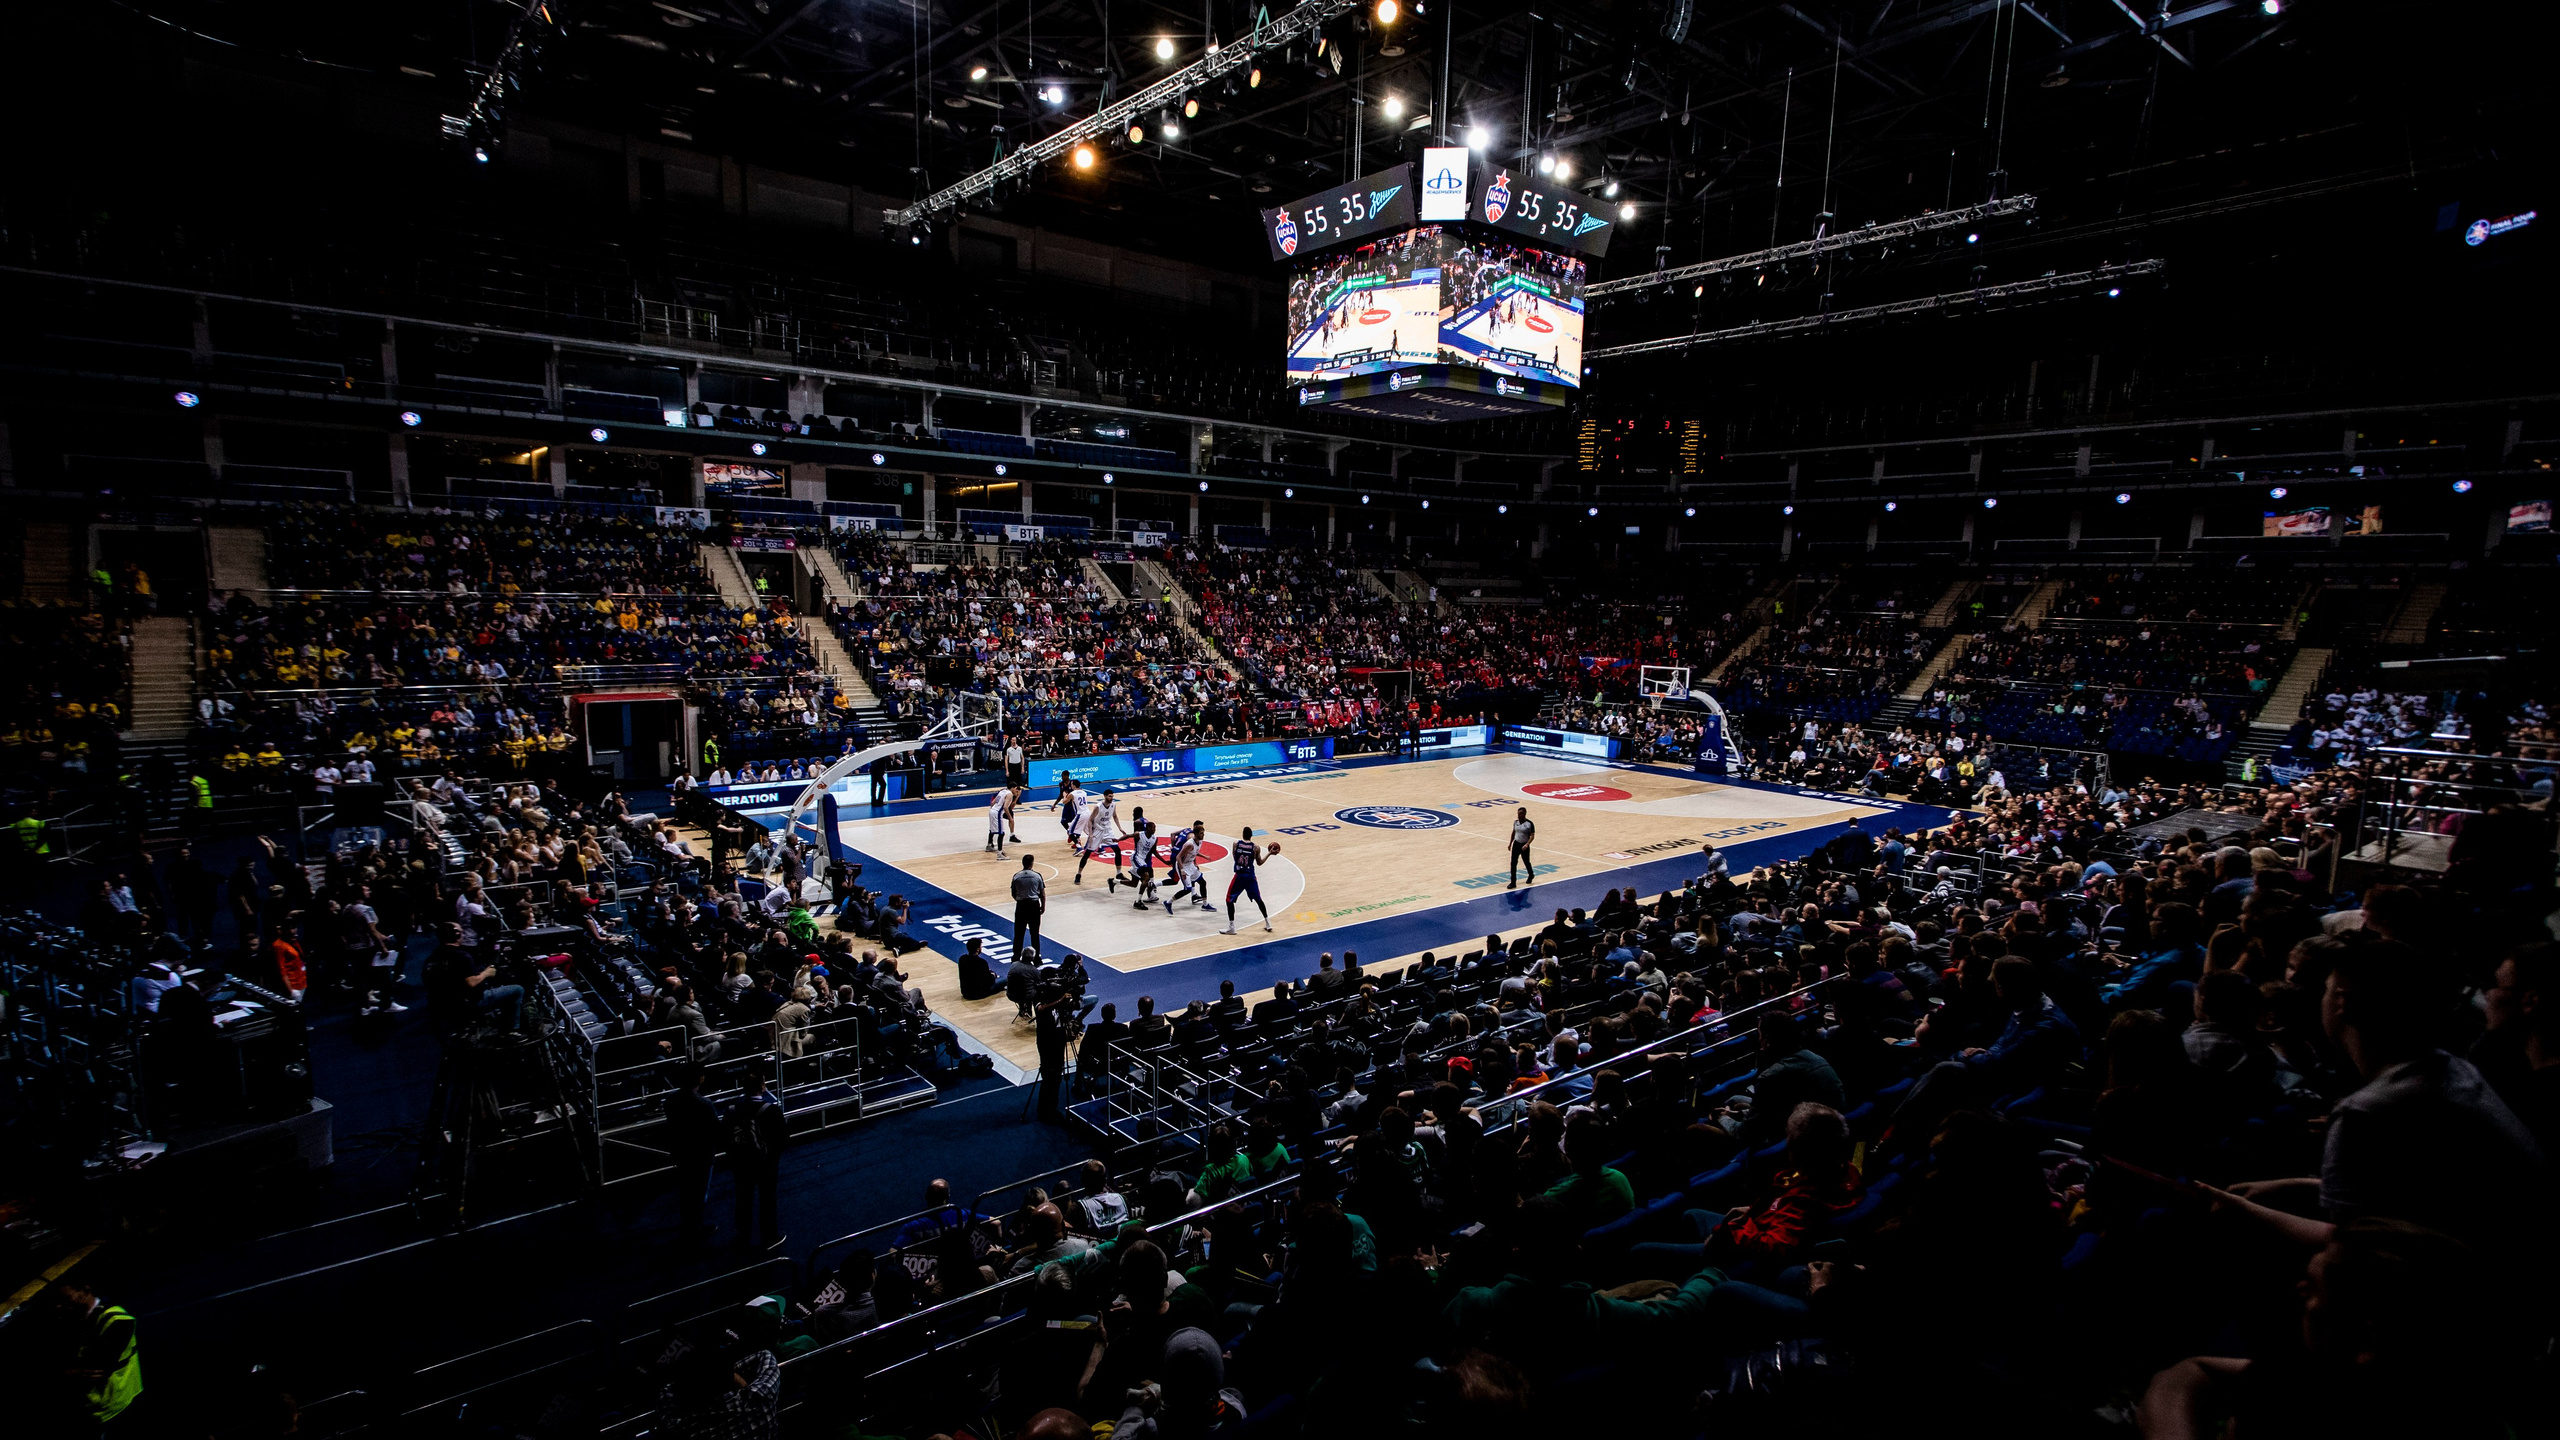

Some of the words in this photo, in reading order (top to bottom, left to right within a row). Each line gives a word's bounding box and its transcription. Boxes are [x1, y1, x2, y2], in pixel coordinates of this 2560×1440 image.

[1488, 190, 1507, 205] ЦСКА
[1340, 193, 1365, 225] 35
[1517, 190, 1543, 221] 55
[1304, 206, 1328, 236] 55
[1551, 200, 1578, 231] 35
[1278, 225, 1295, 239] ЦСКА
[1334, 226, 1341, 238] 3
[1539, 223, 1547, 235] 3
[628, 455, 660, 470] 306
[872, 473, 900, 488] 308
[848, 519, 872, 532] ВТБ
[1020, 528, 1040, 539] ВТБ
[1297, 746, 1317, 759] ВТБ
[1152, 758, 1175, 772] ВТБ
[1146, 772, 1250, 787] MOSCOW
[1249, 766, 1312, 777] 2018
[713, 792, 779, 806] NERATION
[1077, 796, 1087, 806] 24
[1465, 798, 1520, 809] ВТБ
[1275, 822, 1342, 837] ВТБ
[1702, 820, 1789, 840] СОГАЗ
